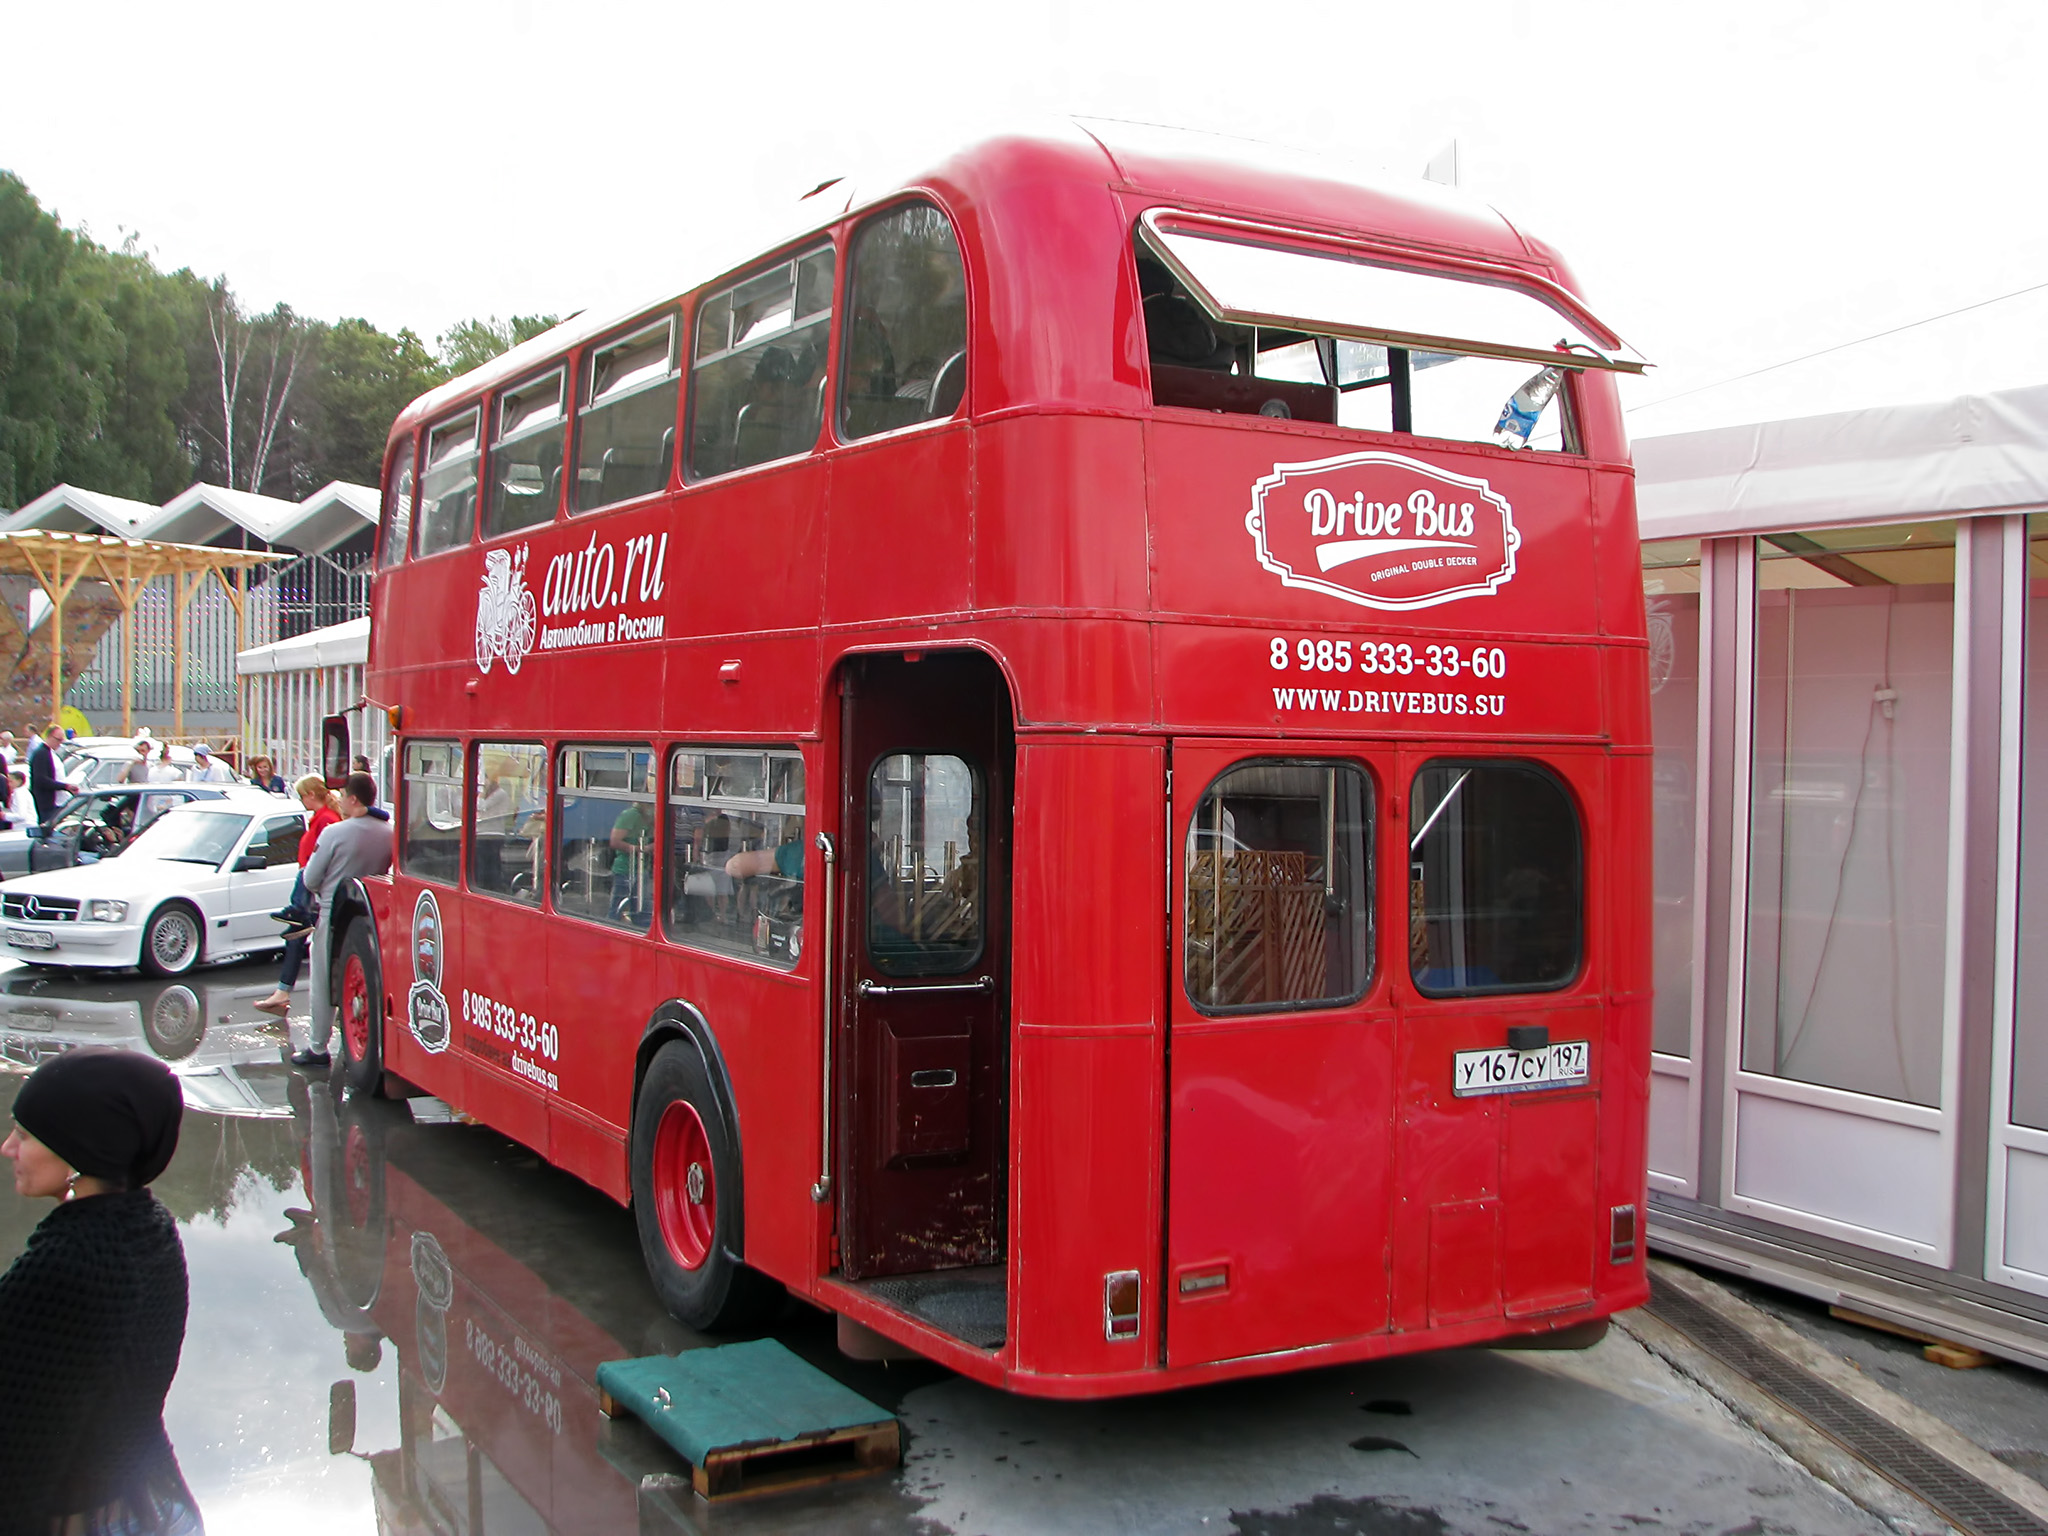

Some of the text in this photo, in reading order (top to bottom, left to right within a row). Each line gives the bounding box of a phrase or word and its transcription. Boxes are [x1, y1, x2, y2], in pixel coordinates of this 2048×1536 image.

[1304, 488, 1475, 537] Drive Bus
[542, 530, 668, 617] auto.ru
[1370, 557, 1477, 582] ORIGINAL DOUBLE DECKER
[539, 613, 664, 649] Автомобили в России
[1269, 637, 1506, 678] 8 985 333-33-60
[1272, 687, 1505, 716] WWW.DRIVEBUS.SU
[462, 988, 470, 1021] 8
[471, 992, 492, 1031] 985
[494, 1001, 558, 1061] 333-33-60
[512, 1049, 559, 1091] drivebus.su
[1553, 1045, 1582, 1067] 197
[1559, 1068, 1574, 1076] RUS
